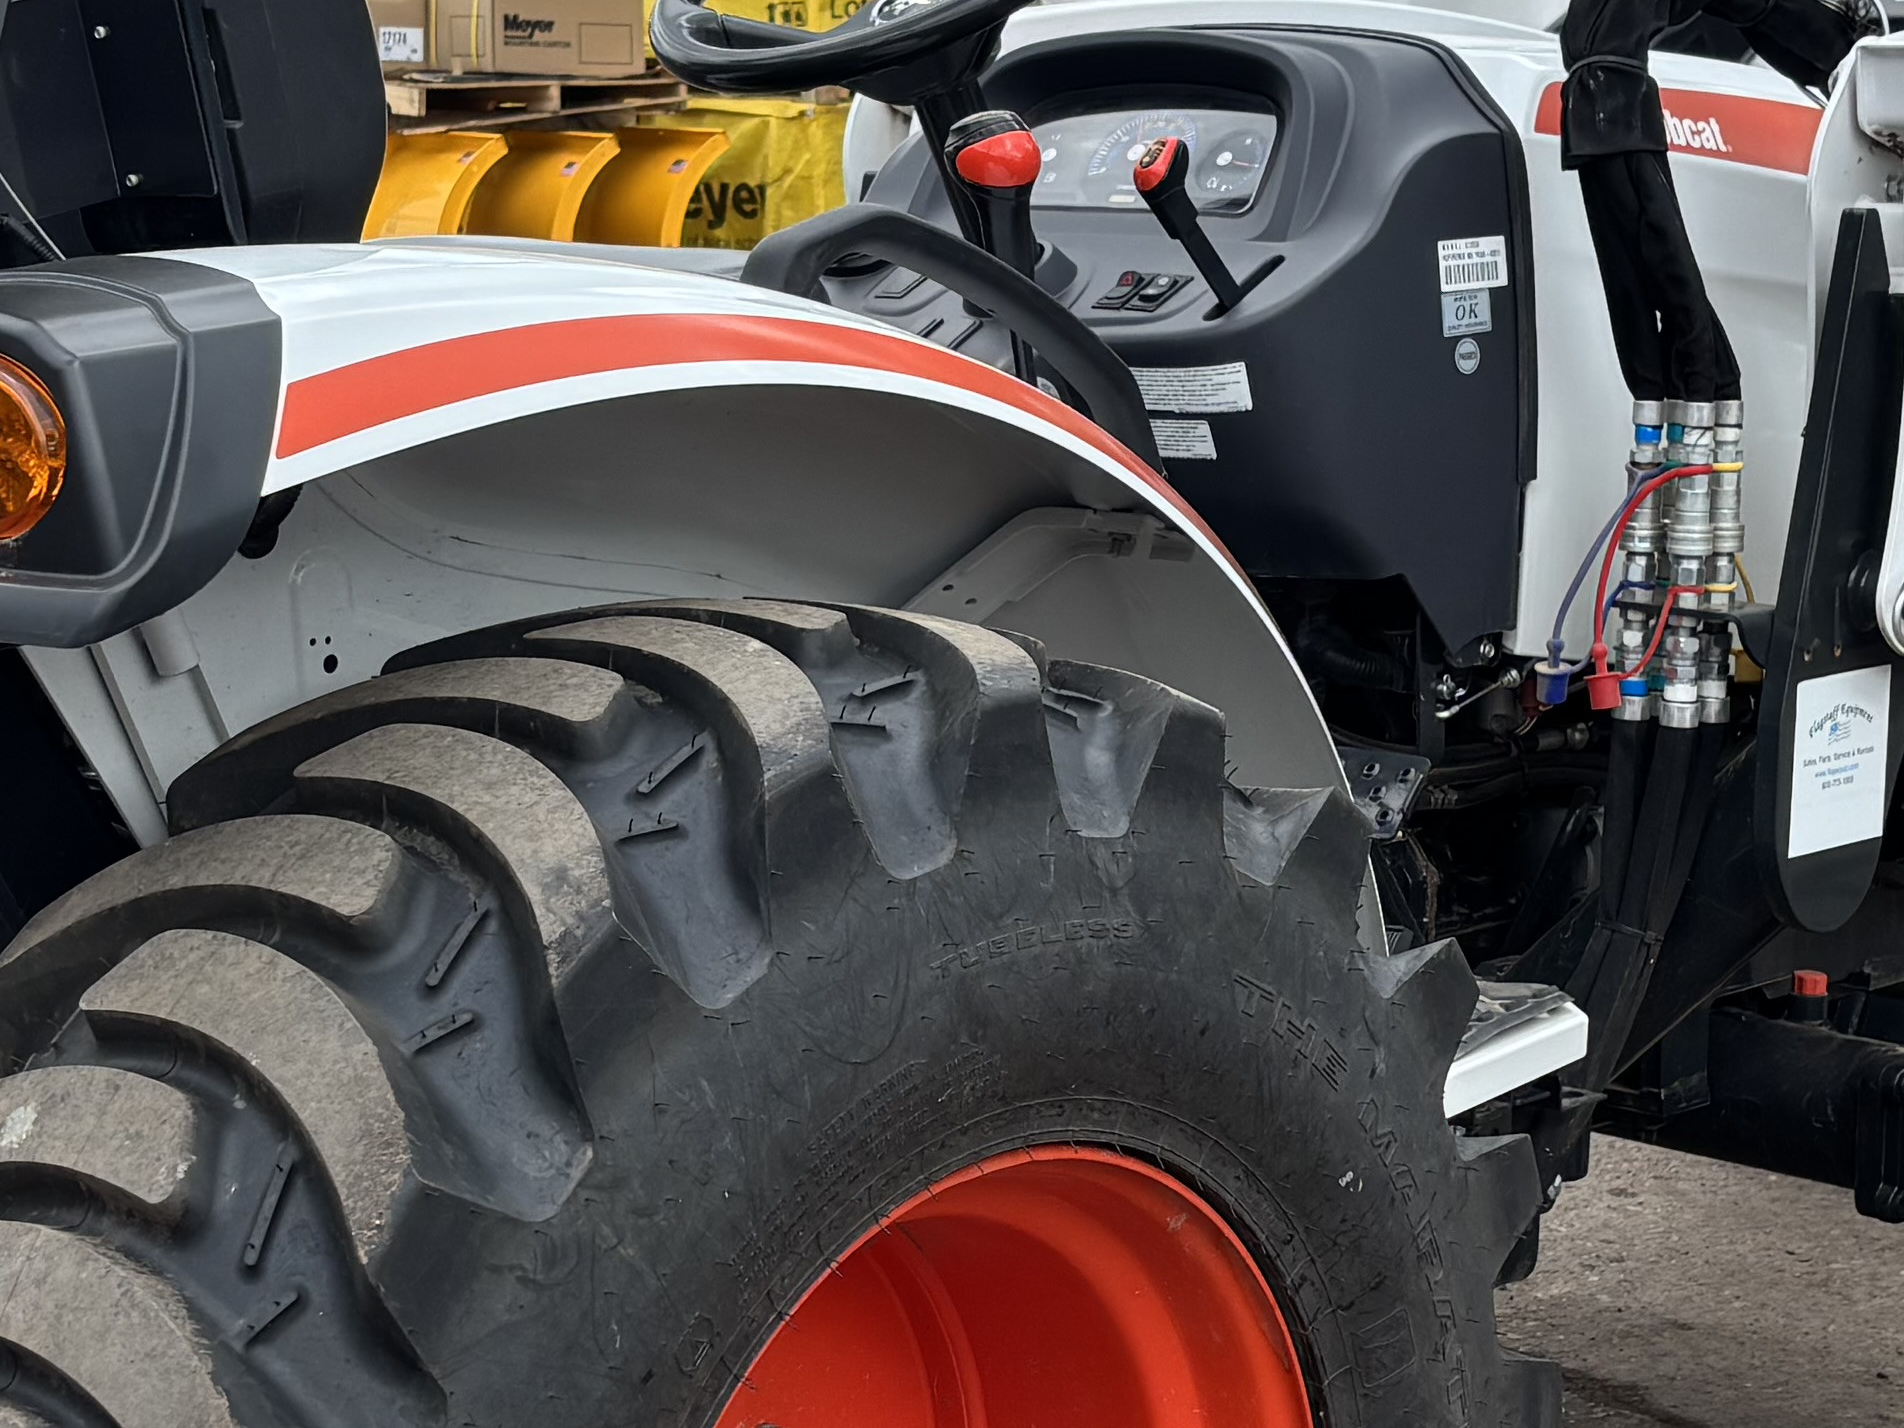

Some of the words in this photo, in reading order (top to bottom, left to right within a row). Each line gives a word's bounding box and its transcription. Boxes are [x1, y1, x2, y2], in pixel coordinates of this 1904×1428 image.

[503, 13, 556, 40] Meyer
[1662, 108, 1728, 153] bcat
[1455, 302, 1479, 321] OK
